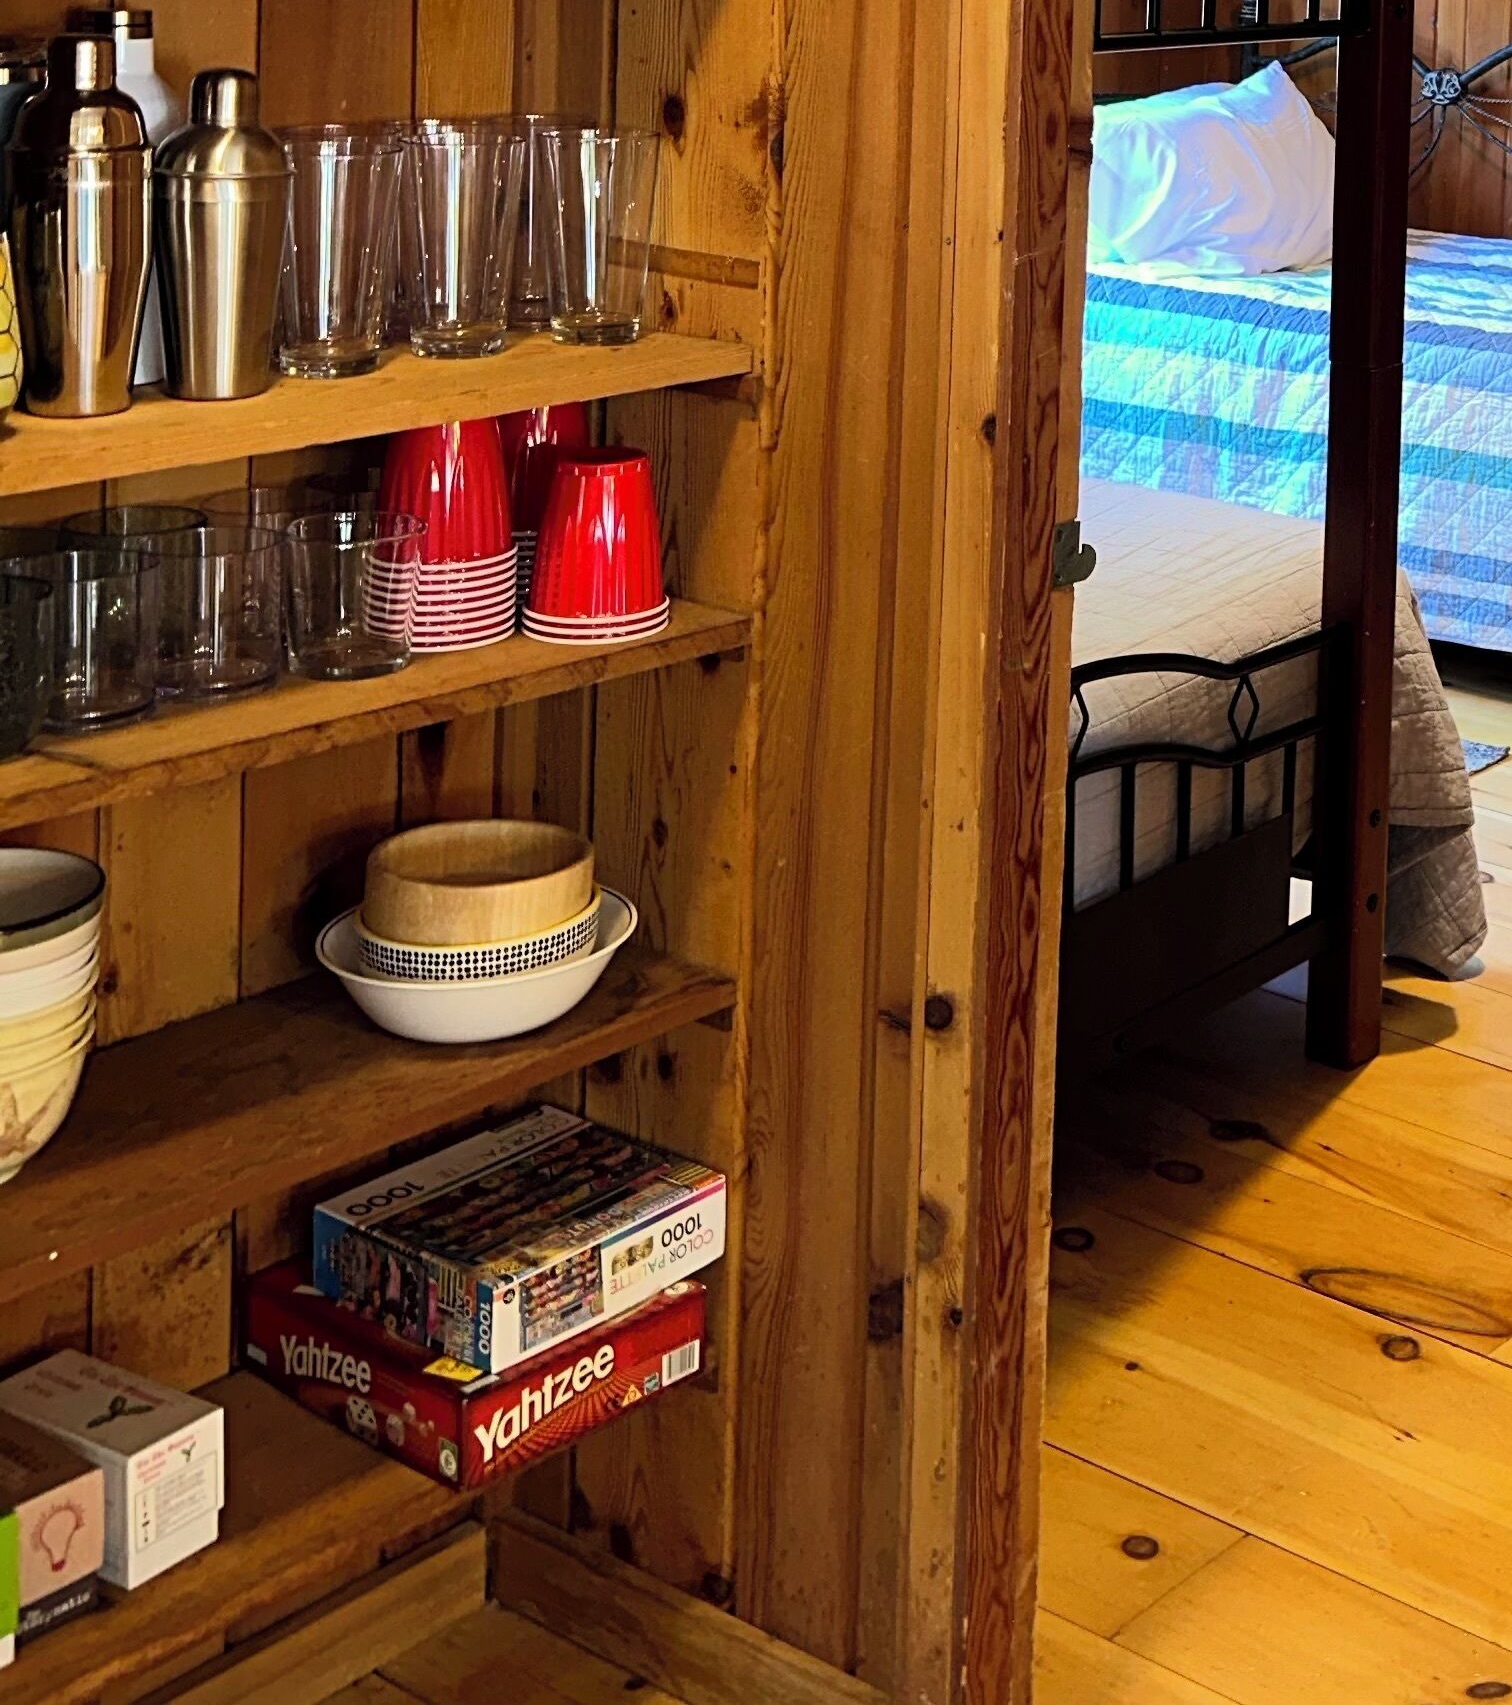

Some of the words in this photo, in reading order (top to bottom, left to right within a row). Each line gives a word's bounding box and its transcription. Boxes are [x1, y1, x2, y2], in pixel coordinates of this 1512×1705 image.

[346, 1180, 425, 1217] 1000
[660, 1212, 703, 1248] 1000
[669, 1228, 715, 1264] COLOR
[609, 1255, 665, 1295] PALTTE
[478, 1301, 492, 1355] 1000
[279, 1334, 372, 1394] Yahtzee
[473, 1344, 615, 1463] Yahtzee
